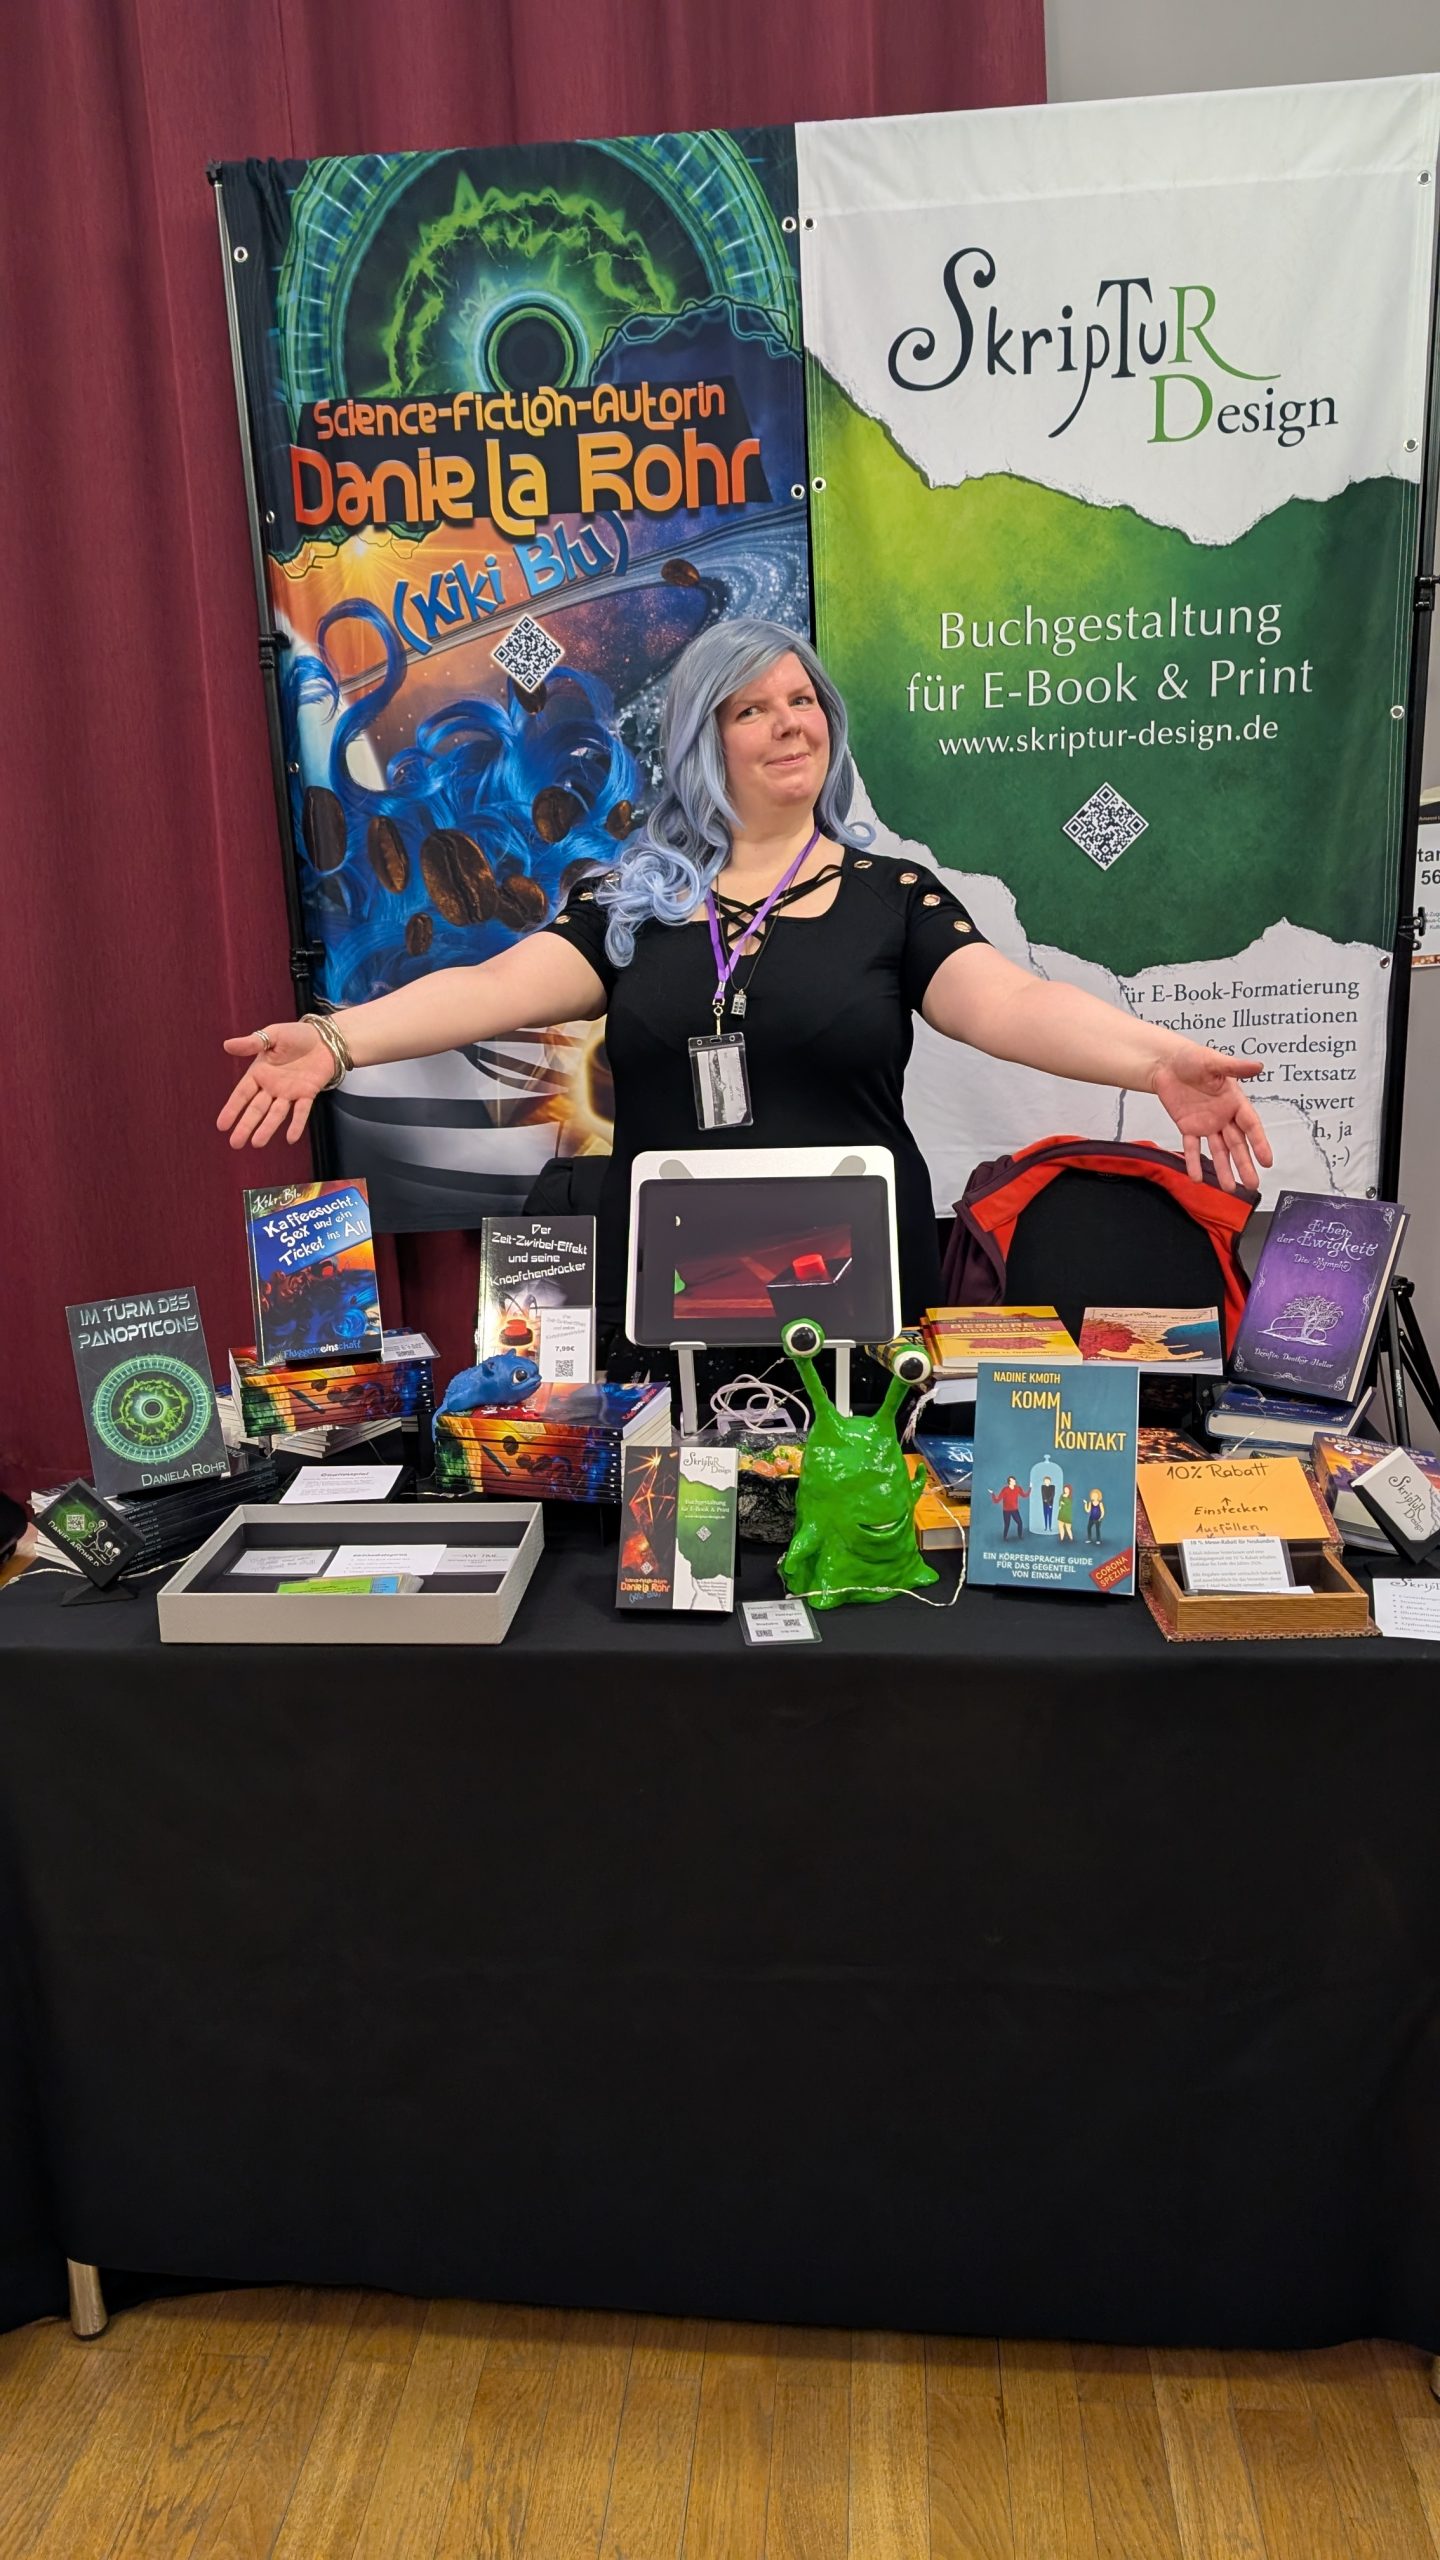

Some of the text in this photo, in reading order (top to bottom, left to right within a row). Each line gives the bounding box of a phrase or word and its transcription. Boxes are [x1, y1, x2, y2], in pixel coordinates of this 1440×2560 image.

[312, 382, 726, 440] Science-Fiction-Autorin
[1147, 373, 1338, 447] Design
[578, 429, 761, 513] Rohr
[393, 511, 630, 656] (Kiki Blu)
[940, 597, 1282, 656] Buchgestaltung
[906, 657, 1314, 712] für E-Book & Print
[939, 714, 1279, 757] www.skriptur-design.de
[1152, 979, 1360, 1003] E-Book-Formatierung
[1232, 1006, 1358, 1028] Illustrationen
[1241, 1034, 1357, 1058] Coverdesign
[1280, 1063, 1357, 1082] Textsatz
[1336, 1121, 1352, 1143] ja
[279, 1210, 353, 1247] Sex und ein
[531, 1224, 551, 1235] Der
[1308, 1219, 1353, 1241] Erben
[278, 1220, 368, 1266] Ticket ins All
[492, 1232, 588, 1255] Zeit-Zwirbel-Effekt
[1276, 1231, 1379, 1261] der Ewigkeit
[508, 1252, 560, 1263] und seine
[1294, 1253, 1309, 1264] Die
[489, 1262, 587, 1287] Knöpfchendrücker
[80, 1293, 190, 1326] IM TURM DES
[78, 1314, 199, 1349] PANOPTICONS
[993, 1371, 1061, 1384] NADINE KMOTH
[1011, 1390, 1061, 1410] KOMM
[1055, 1430, 1127, 1451] KONTAKT
[1166, 1462, 1269, 1480] 10% Rabatt
[1194, 1503, 1269, 1515] Einstecken
[1196, 1522, 1259, 1534] Ausfüllen
[983, 1551, 1093, 1566] EIN KÖRPERSPRACHE GUIDE
[996, 1560, 1076, 1573] FÜR DAS GEGENTEIL
[1095, 1555, 1129, 1580] CORONA
[1012, 1570, 1062, 1580] VON EINSAM
[1100, 1564, 1131, 1588] SPEZIAL
